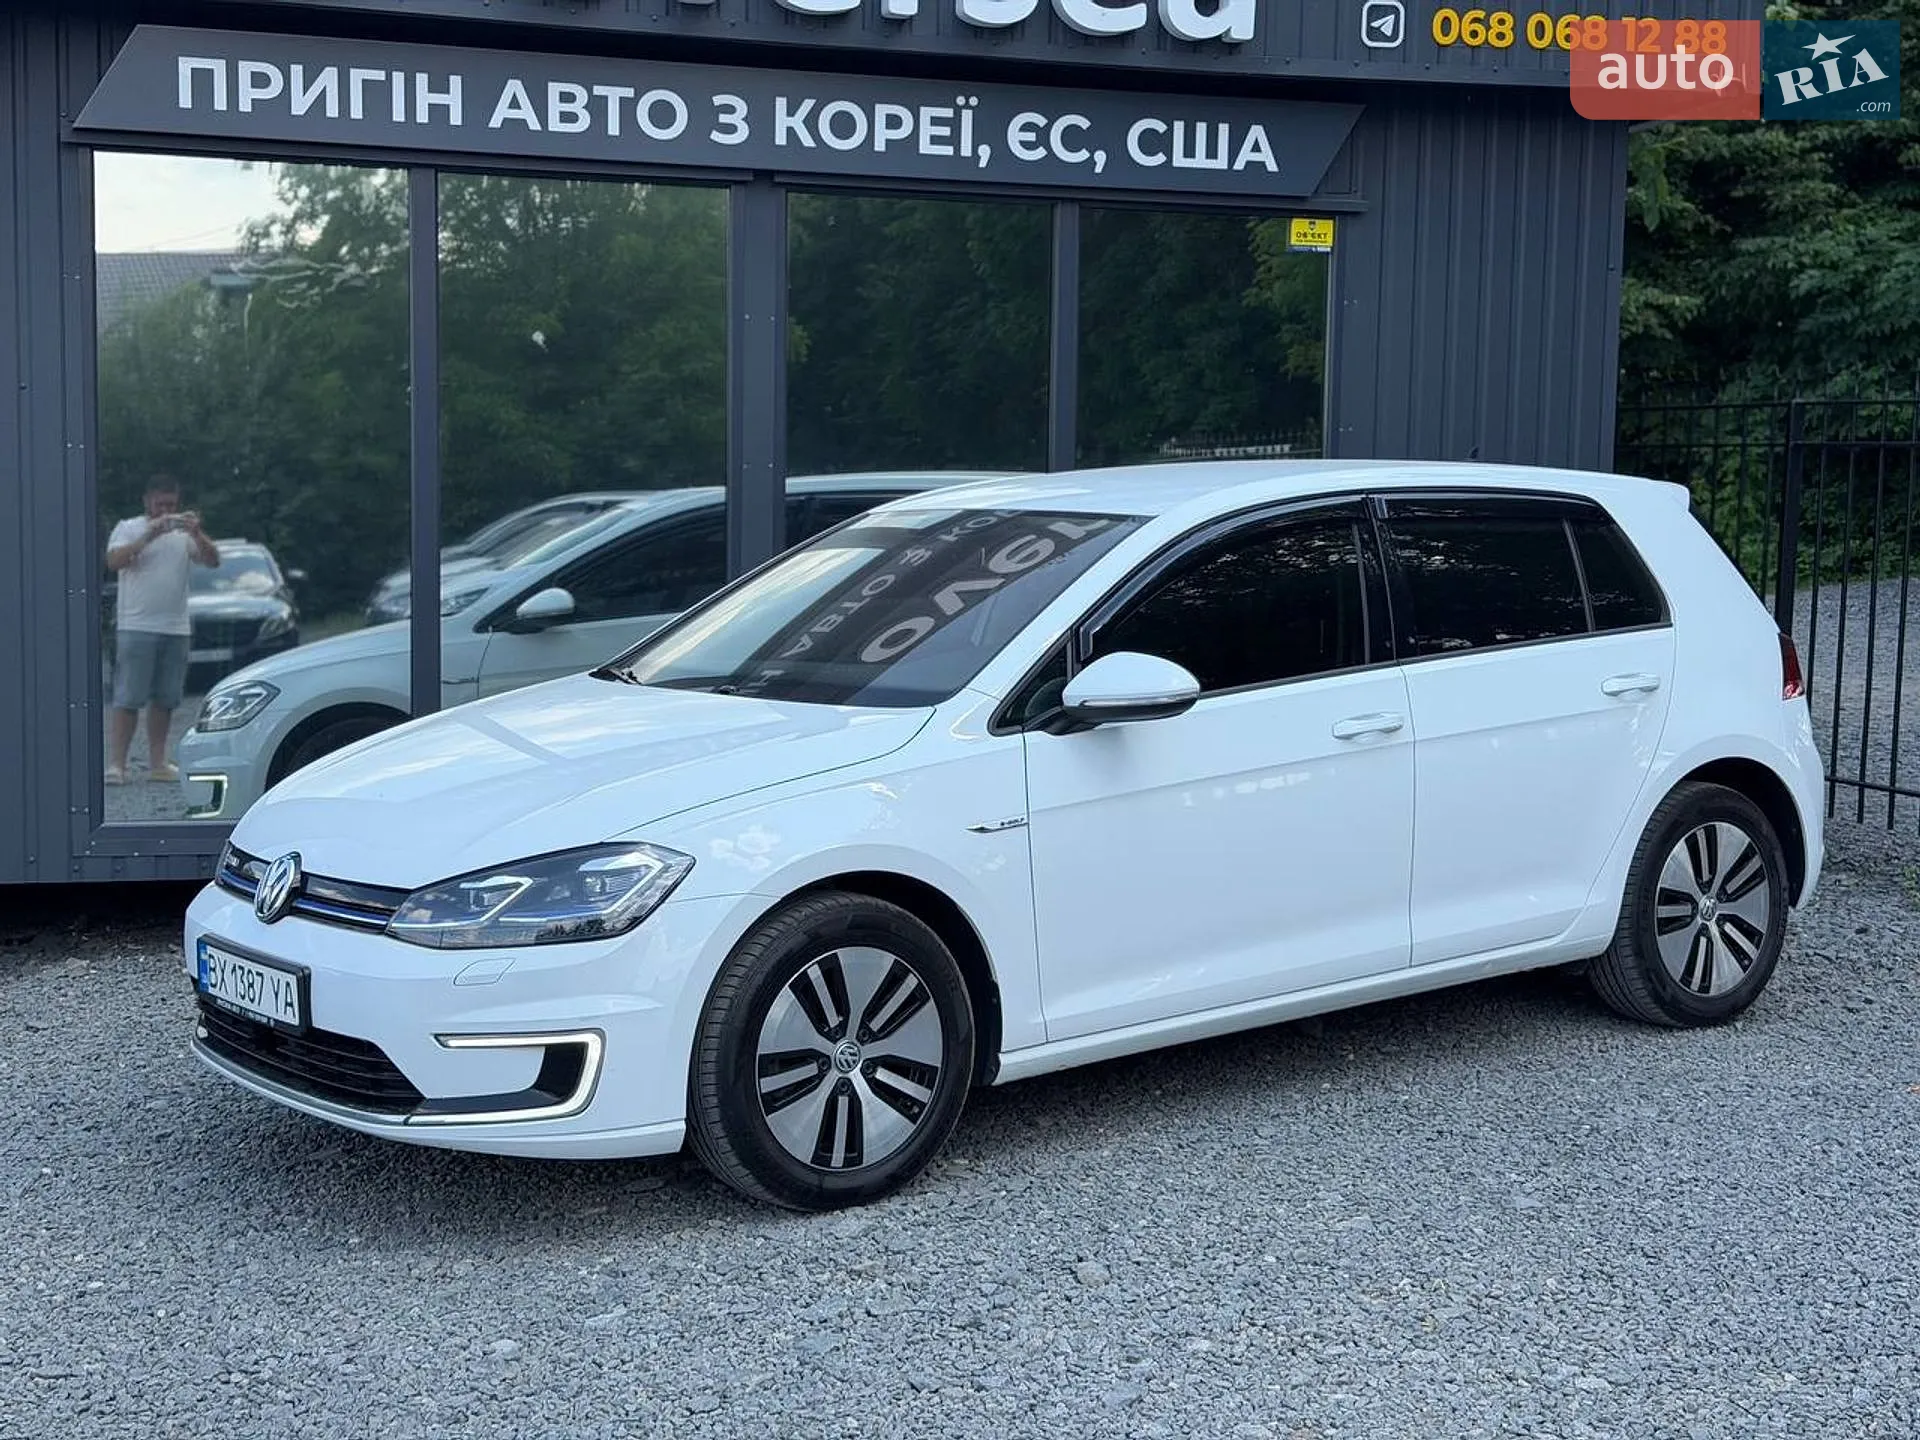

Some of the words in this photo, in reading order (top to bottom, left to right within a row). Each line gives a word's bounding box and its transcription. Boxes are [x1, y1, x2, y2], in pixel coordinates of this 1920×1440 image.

[1431, 8, 1515, 48] 068
[1526, 11, 1608, 52] 068
[1621, 16, 1661, 53] 12
[1674, 19, 1728, 56] 88
[177, 56, 463, 126] ПРИГІН
[488, 79, 689, 141] АВТО
[709, 94, 751, 145] З
[774, 95, 992, 167] КОРЕЇ,
[1006, 111, 1107, 173] ЄС,
[1126, 117, 1279, 173] США
[231, 963, 264, 1007] 1387
